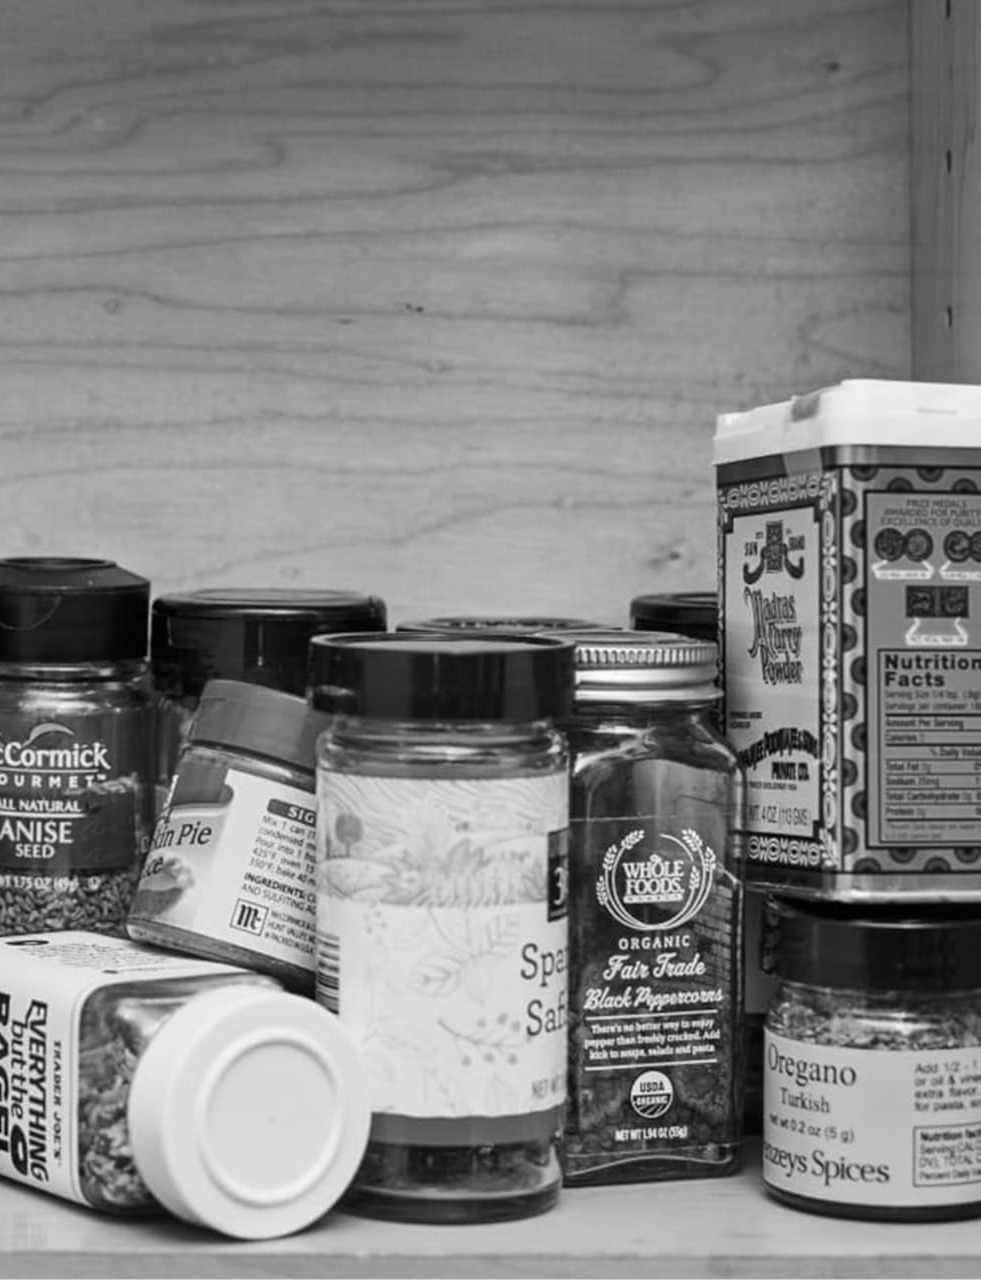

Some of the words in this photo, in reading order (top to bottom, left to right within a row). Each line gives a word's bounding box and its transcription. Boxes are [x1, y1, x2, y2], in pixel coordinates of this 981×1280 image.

[884, 653, 981, 670] Nutrition
[884, 671, 946, 687] Facts
[19, 799, 82, 813] NATURAL
[176, 821, 212, 846] Pie
[258, 826, 305, 848] condensed
[15, 844, 55, 859] SEED
[276, 865, 297, 880] bake
[280, 857, 301, 869] oven
[623, 857, 685, 878] WHOLE
[242, 883, 262, 896] AND
[244, 871, 306, 900] INGREDIENTS:
[618, 934, 691, 950] ORGANIC
[520, 942, 567, 987] Spa
[603, 953, 650, 980] Fair
[653, 952, 707, 978] Trade
[583, 986, 632, 1010] Black
[633, 986, 724, 1011] Peppercorns
[526, 990, 567, 1036] Saf
[635, 1022, 660, 1032] better
[662, 1021, 679, 1032] way
[691, 1019, 715, 1030] enjoy
[11, 1019, 28, 1069] but
[584, 1038, 615, 1050] pepper
[637, 1033, 666, 1045] freshly
[675, 1044, 691, 1055] and
[53, 1040, 62, 1107] TRADER
[768, 1043, 857, 1087] Oregano
[11, 1069, 28, 1120] the
[25, 998, 49, 1182] EVERYTHING
[639, 1081, 666, 1093] USDA
[914, 1088, 944, 1099] extra
[780, 1086, 831, 1114] Turkish
[53, 1111, 62, 1160] JOE'S
[615, 1129, 629, 1141] NET
[630, 1128, 642, 1140] WT
[807, 1123, 822, 1138] oz
[811, 1149, 891, 1186] Spices
